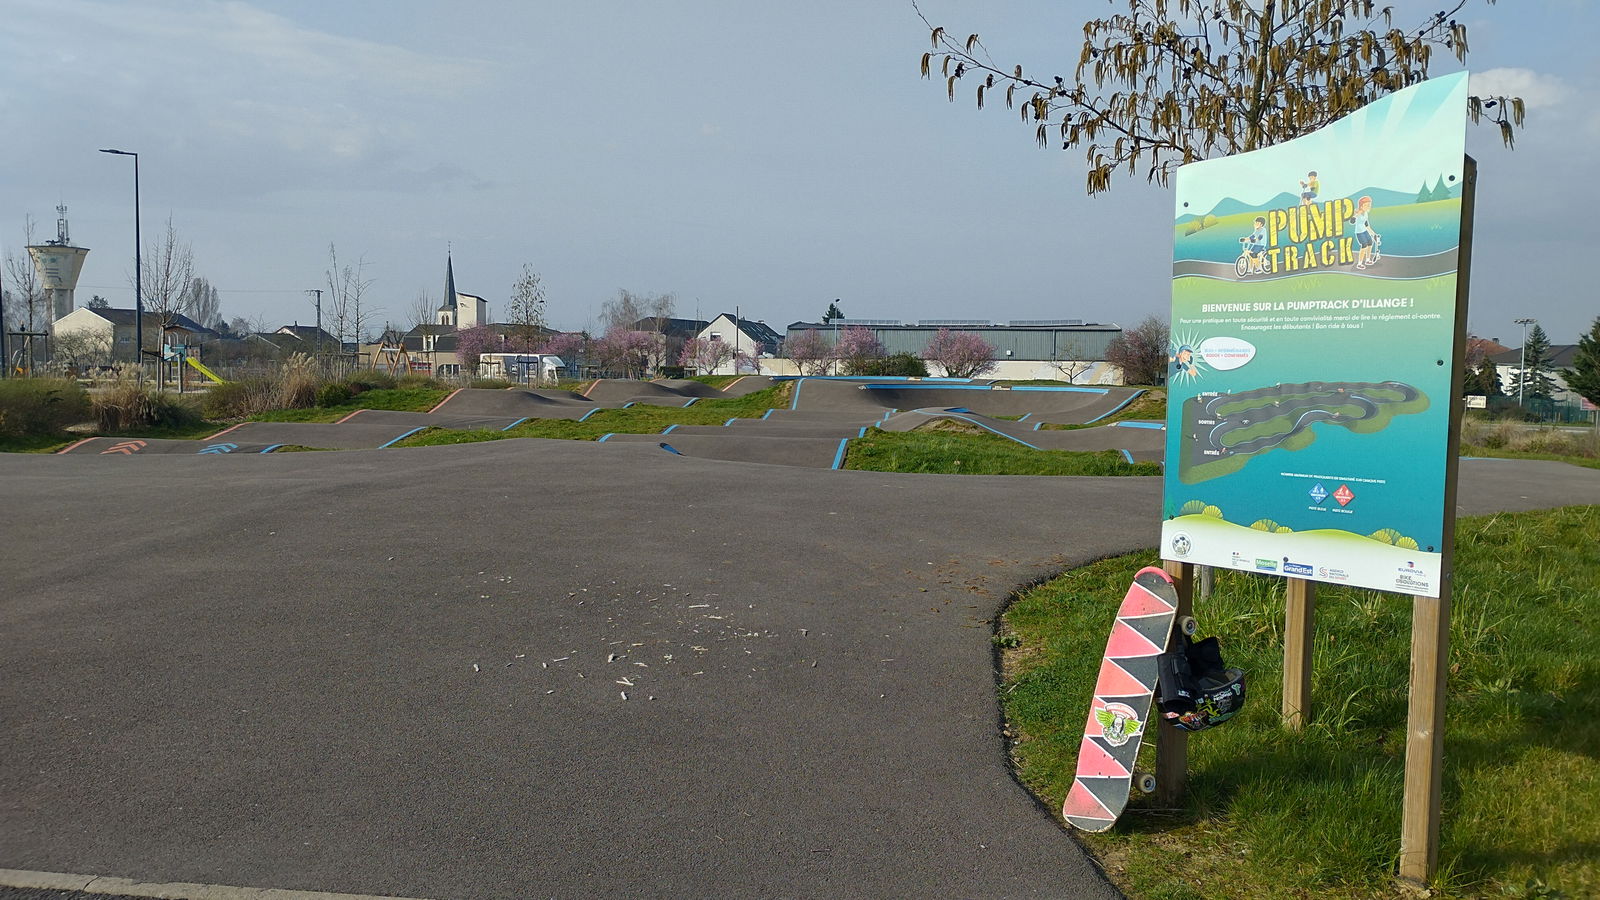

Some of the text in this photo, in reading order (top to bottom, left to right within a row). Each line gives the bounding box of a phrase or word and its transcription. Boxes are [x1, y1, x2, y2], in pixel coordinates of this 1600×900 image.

[1267, 198, 1355, 248] PUMP
[1267, 236, 1355, 274] TRACK
[1201, 297, 1414, 313] BIENVENUE SUR LA PUMPTRACK D'ILLANGE !
[1240, 323, 1273, 332] Encouragez
[1315, 322, 1327, 330] Bon
